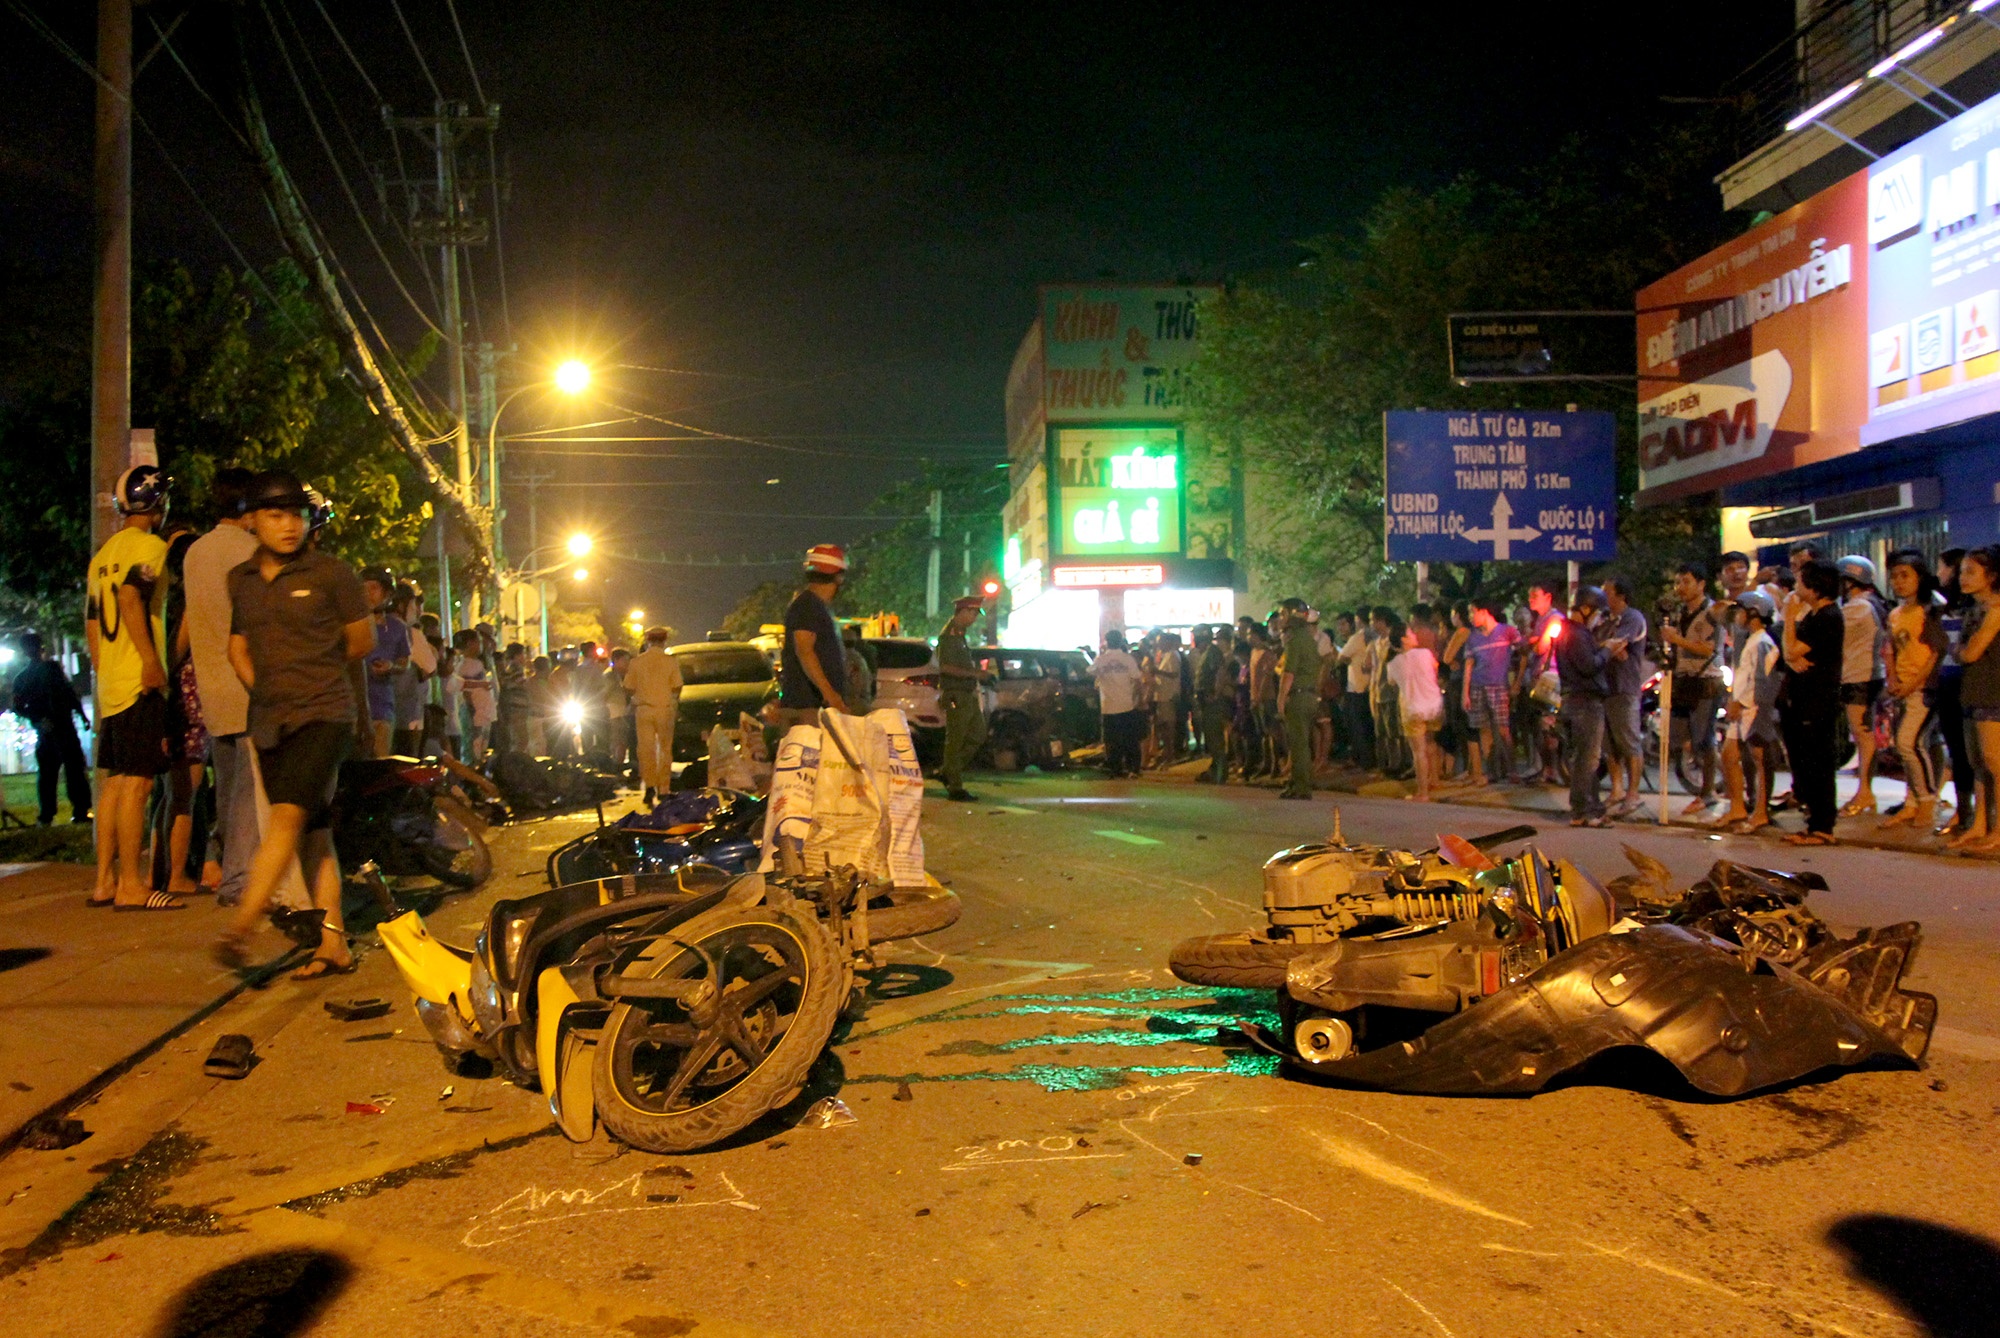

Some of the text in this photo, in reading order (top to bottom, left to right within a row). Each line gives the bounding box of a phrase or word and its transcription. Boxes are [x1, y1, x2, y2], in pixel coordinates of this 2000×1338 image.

[1448, 412, 1480, 437] NGÃ
[1506, 417, 1527, 437] GA
[1532, 421, 1562, 437] 2Km
[1453, 440, 1526, 465] TRUNG TÂM
[1455, 464, 1571, 489] THÀNH PHỐ 13Km
[1391, 493, 1439, 513] UBND
[1441, 509, 1465, 540] LỘC
[1539, 504, 1605, 535] QUỐC LỘ 1
[1552, 535, 1594, 552] 2Km
